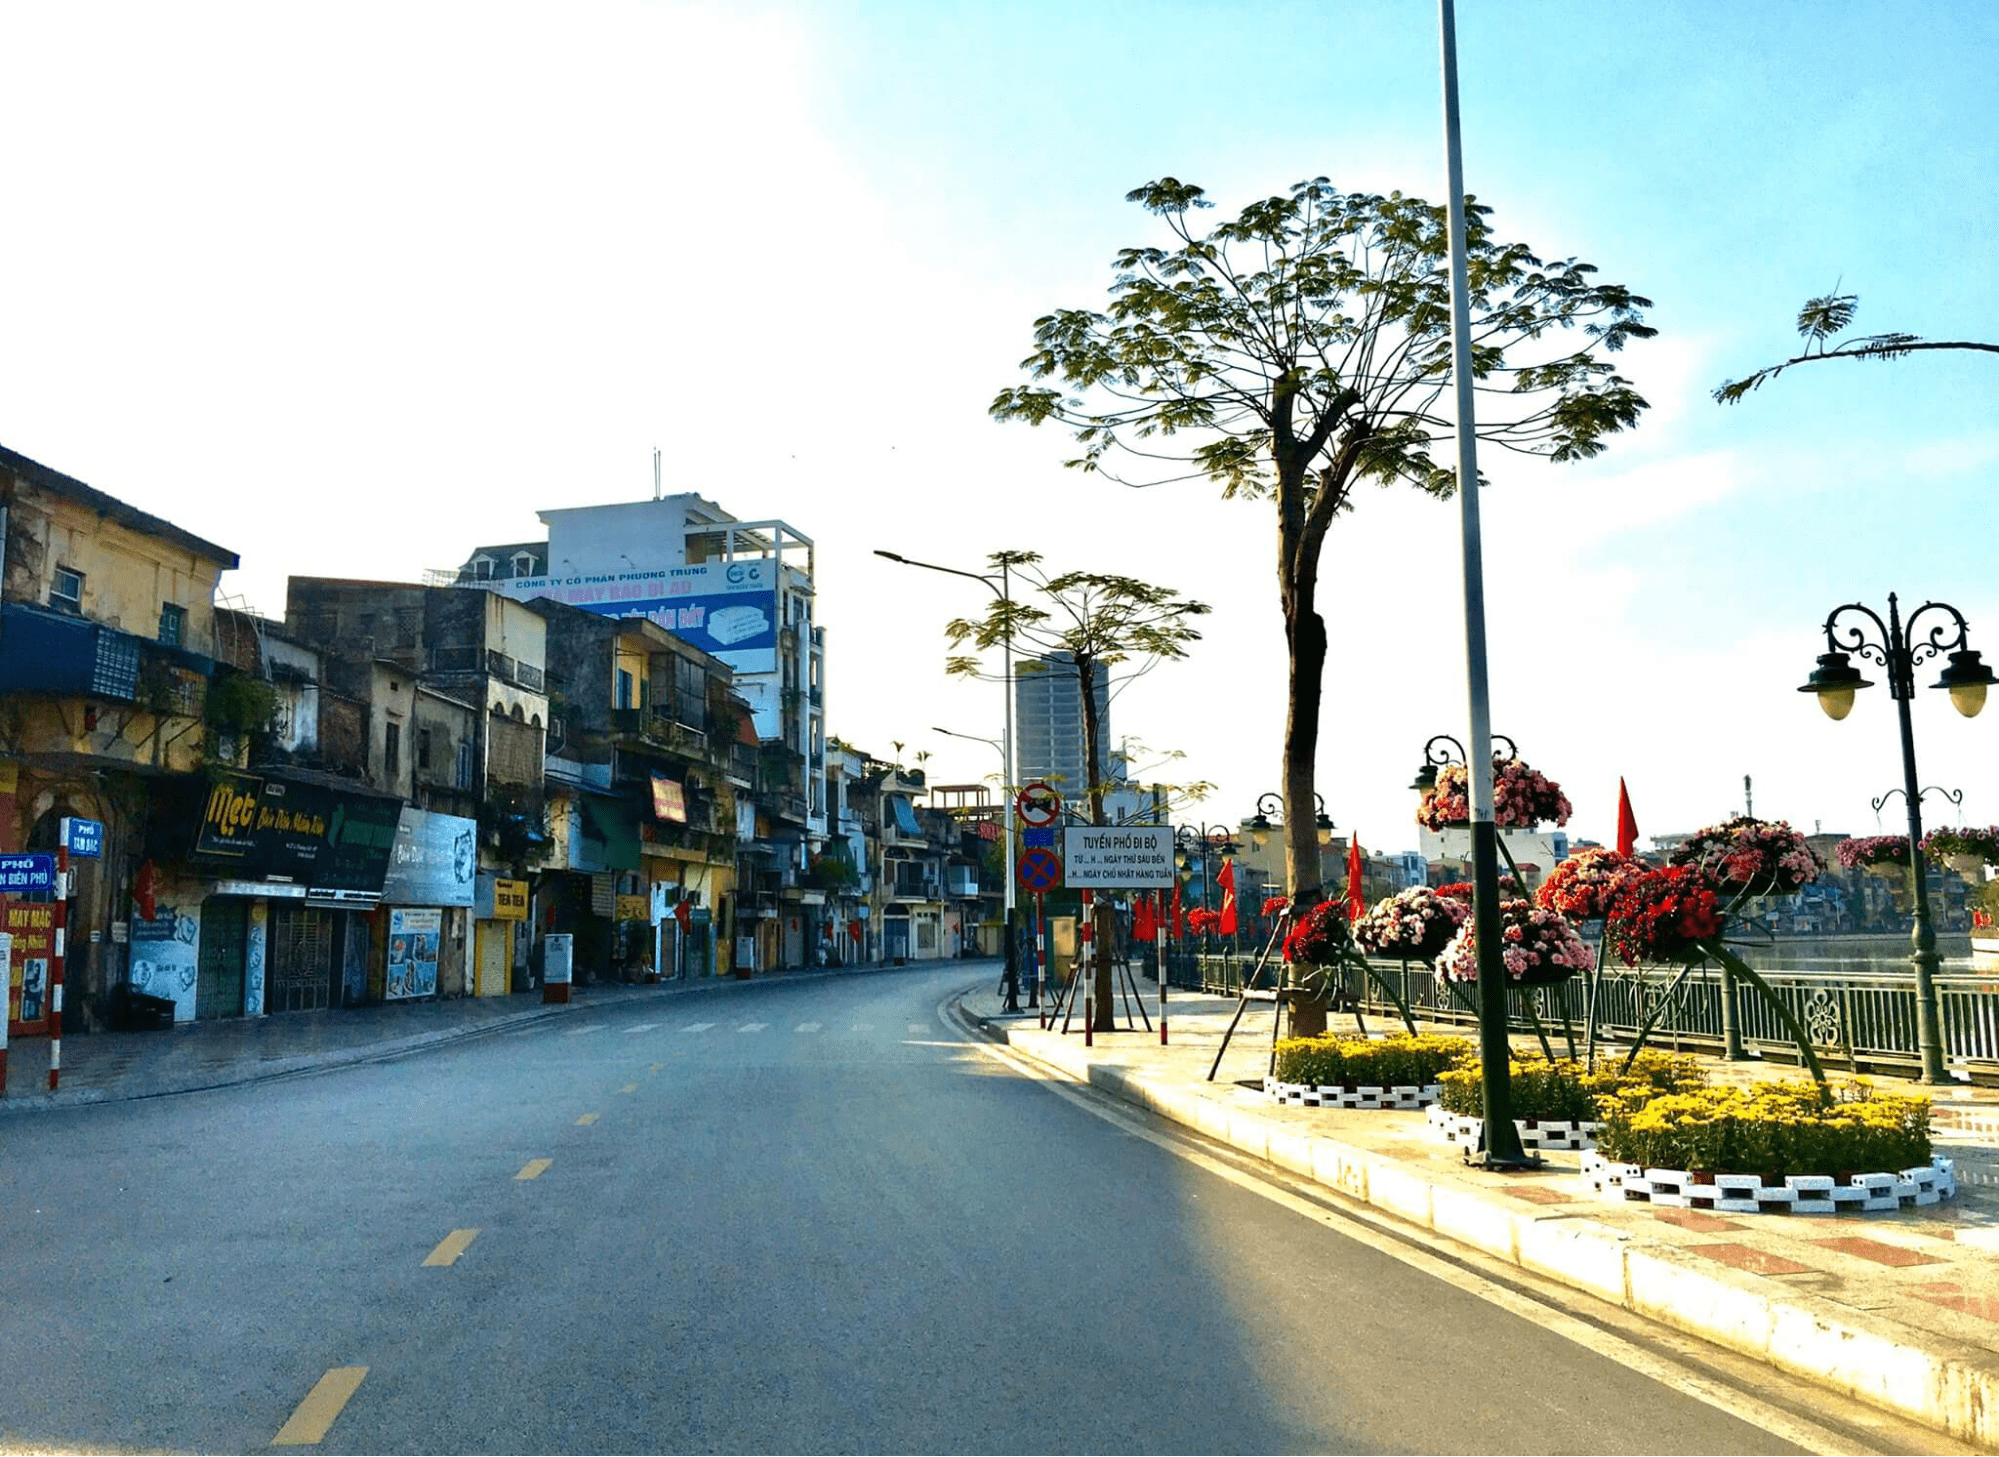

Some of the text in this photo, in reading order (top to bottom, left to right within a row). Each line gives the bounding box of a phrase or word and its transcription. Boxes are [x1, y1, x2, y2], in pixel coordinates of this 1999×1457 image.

[516, 579, 546, 589] CÔNG
[550, 578, 562, 586] TY
[670, 567, 708, 577] TRUNG
[1083, 833, 1158, 851] TUYẾN PHỐ ĐI BỘ
[1, 858, 34, 869] PHỐ
[1104, 853, 1122, 864] NGÀY
[1083, 868, 1101, 878] NGÀY
[8, 909, 30, 927] MAY
